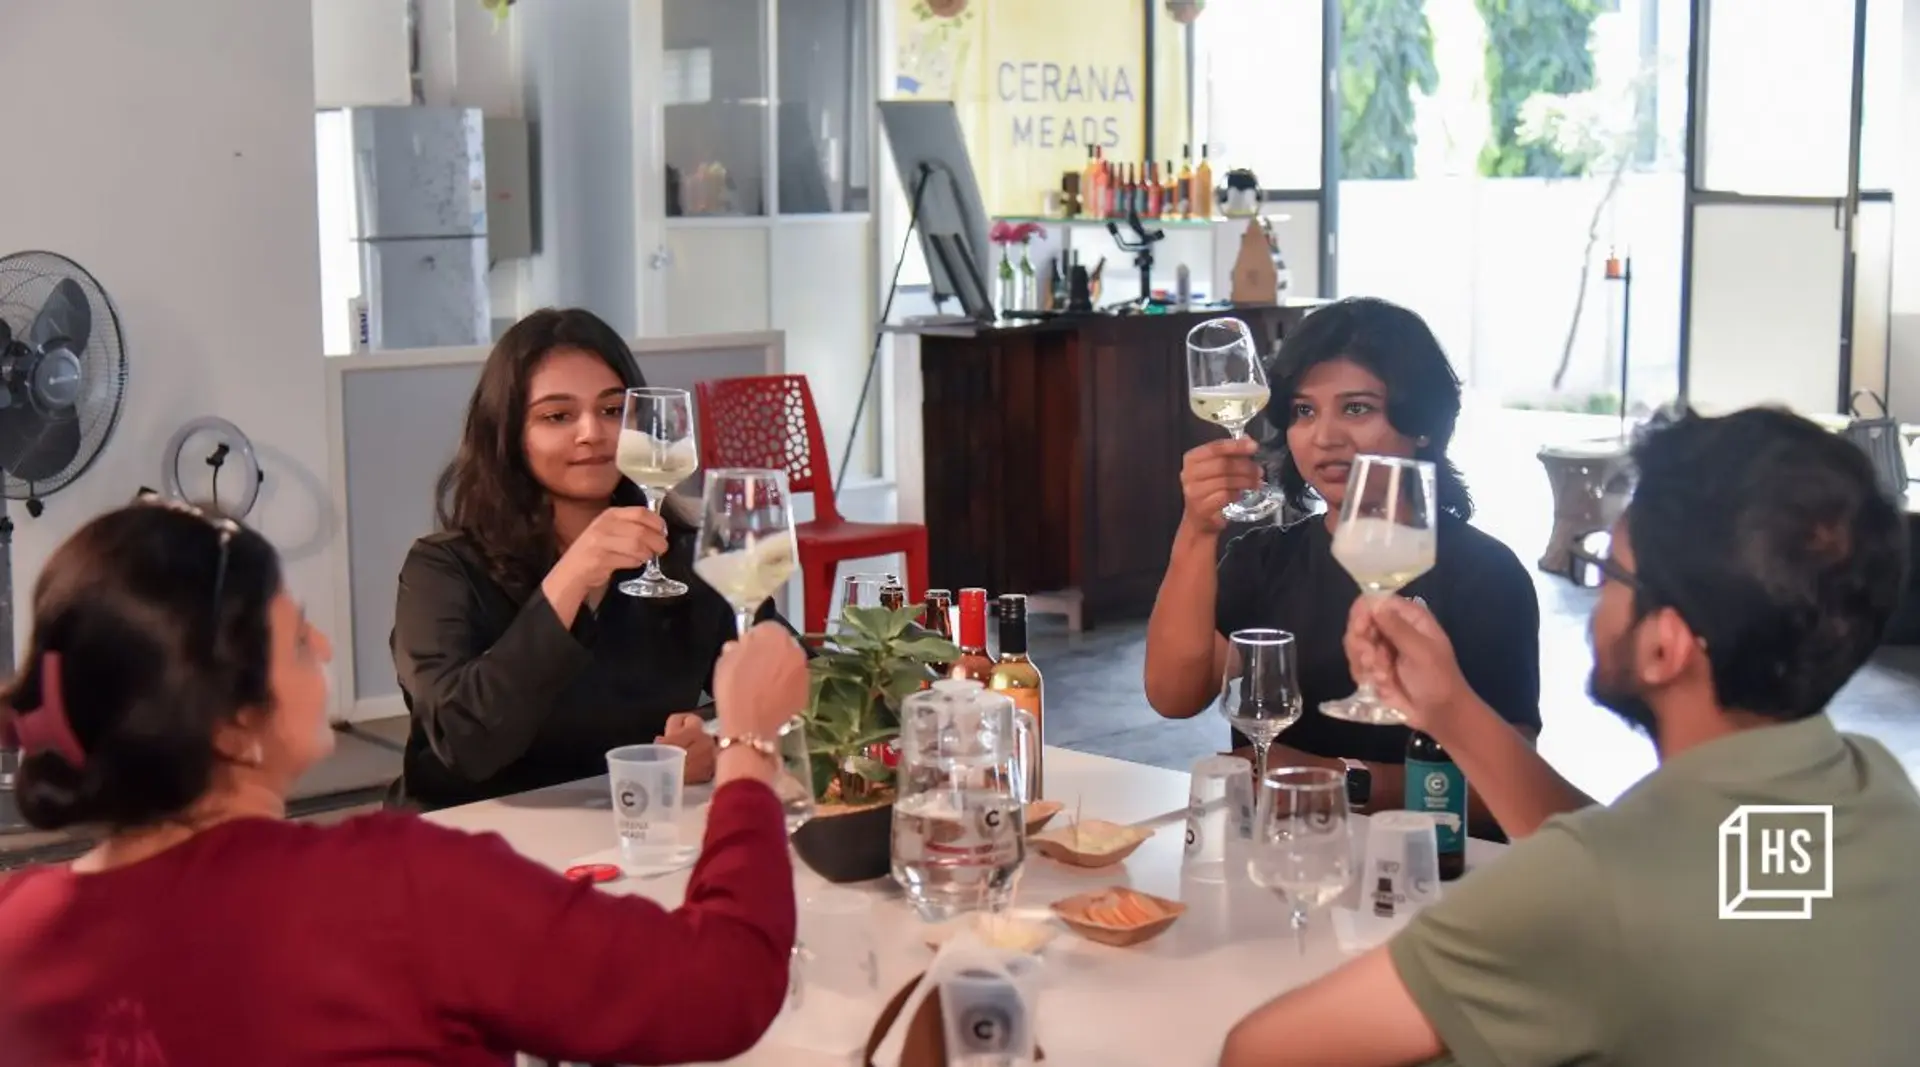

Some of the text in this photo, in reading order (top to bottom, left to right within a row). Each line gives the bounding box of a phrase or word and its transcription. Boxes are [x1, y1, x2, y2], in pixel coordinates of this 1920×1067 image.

[998, 61, 1135, 103] CERANA
[1012, 116, 1120, 149] MEADS
[621, 791, 636, 807] C
[985, 809, 999, 827] C
[973, 1019, 994, 1040] C
